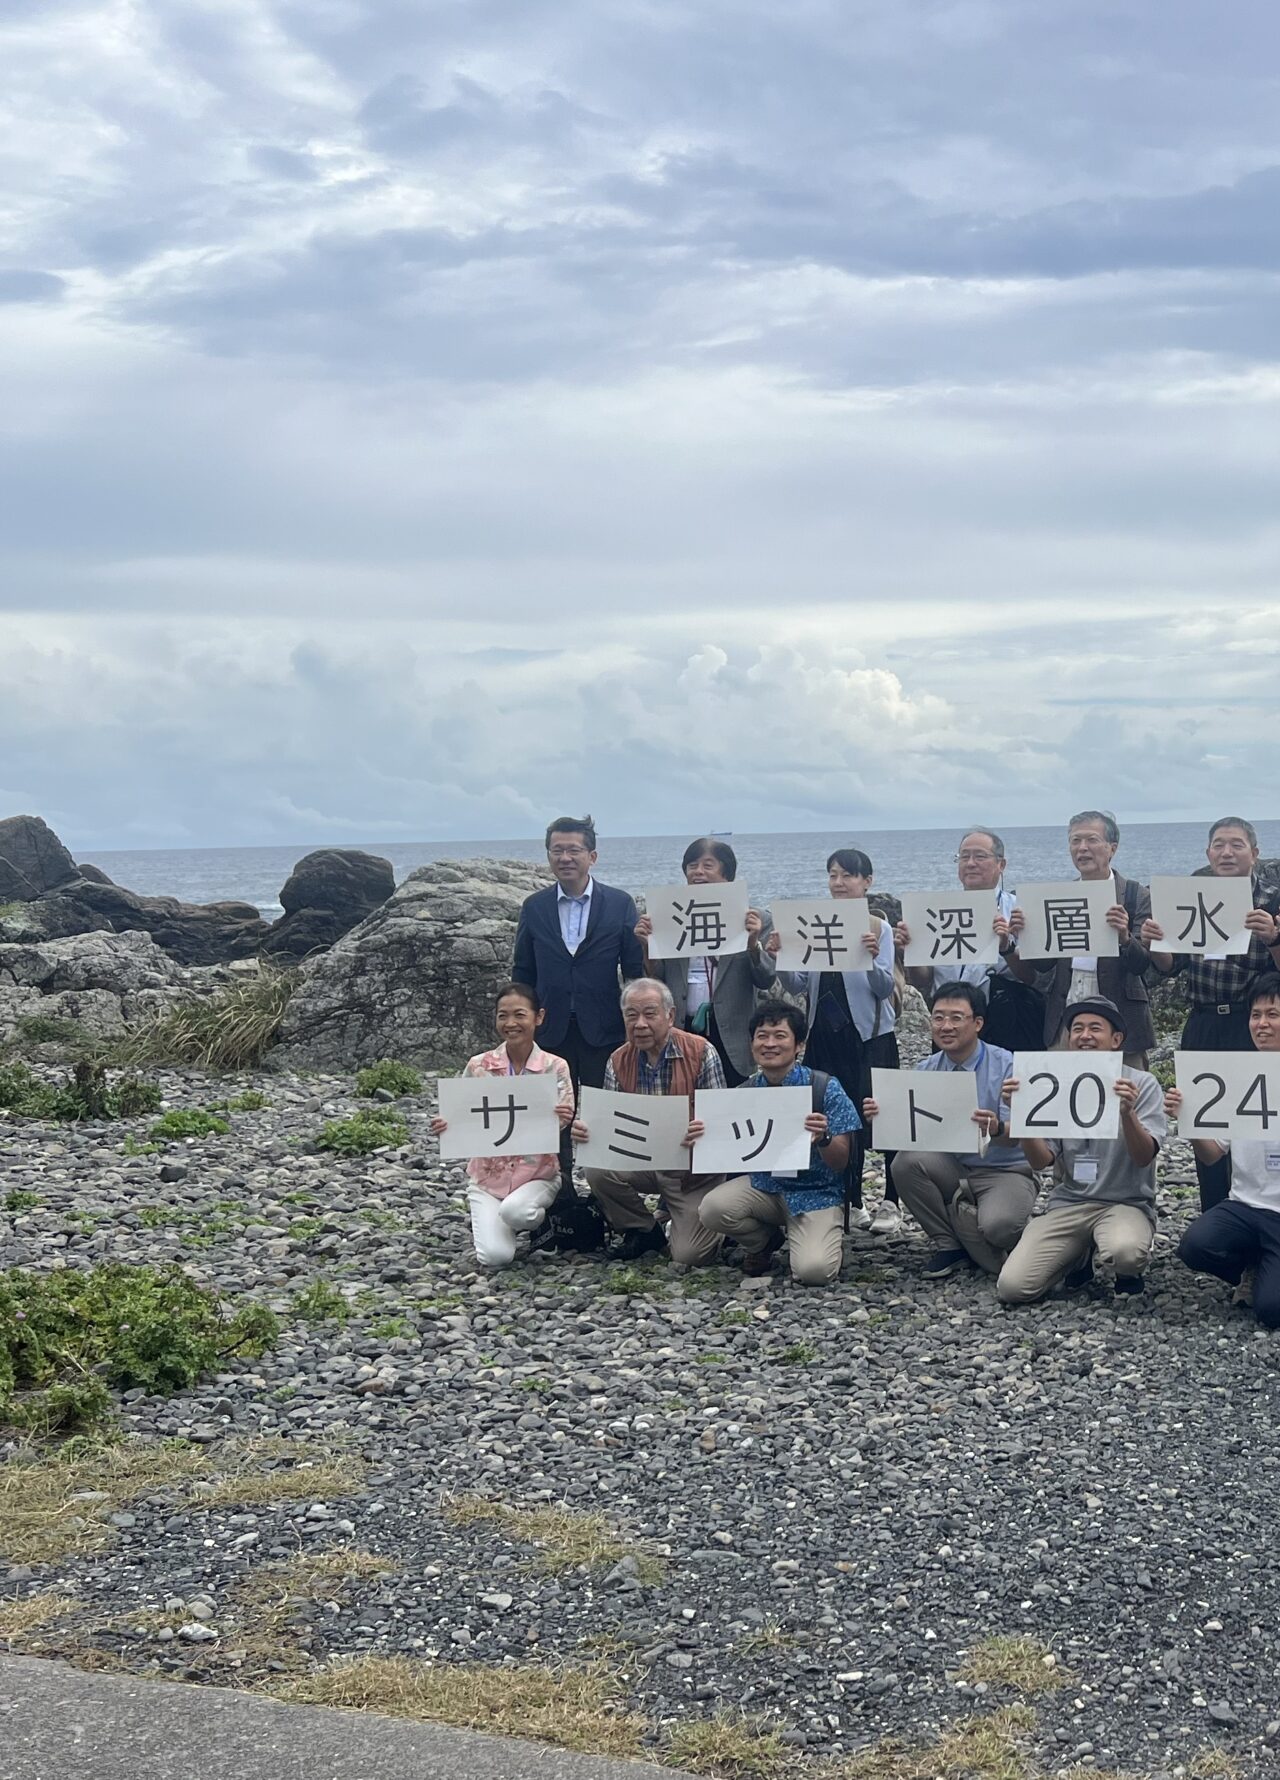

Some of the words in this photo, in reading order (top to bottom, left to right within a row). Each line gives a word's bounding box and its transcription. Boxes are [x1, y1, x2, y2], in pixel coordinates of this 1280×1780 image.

[672, 899, 726, 951] 海
[797, 914, 847, 965] 洋
[926, 907, 977, 959] 深
[1044, 897, 1091, 952] 層
[1176, 892, 1229, 947] 水
[471, 1095, 528, 1147] サ
[909, 1089, 943, 1142] ト
[1025, 1072, 1106, 1129] 20
[1192, 1072, 1278, 1129] 24
[608, 1111, 652, 1161] ミ
